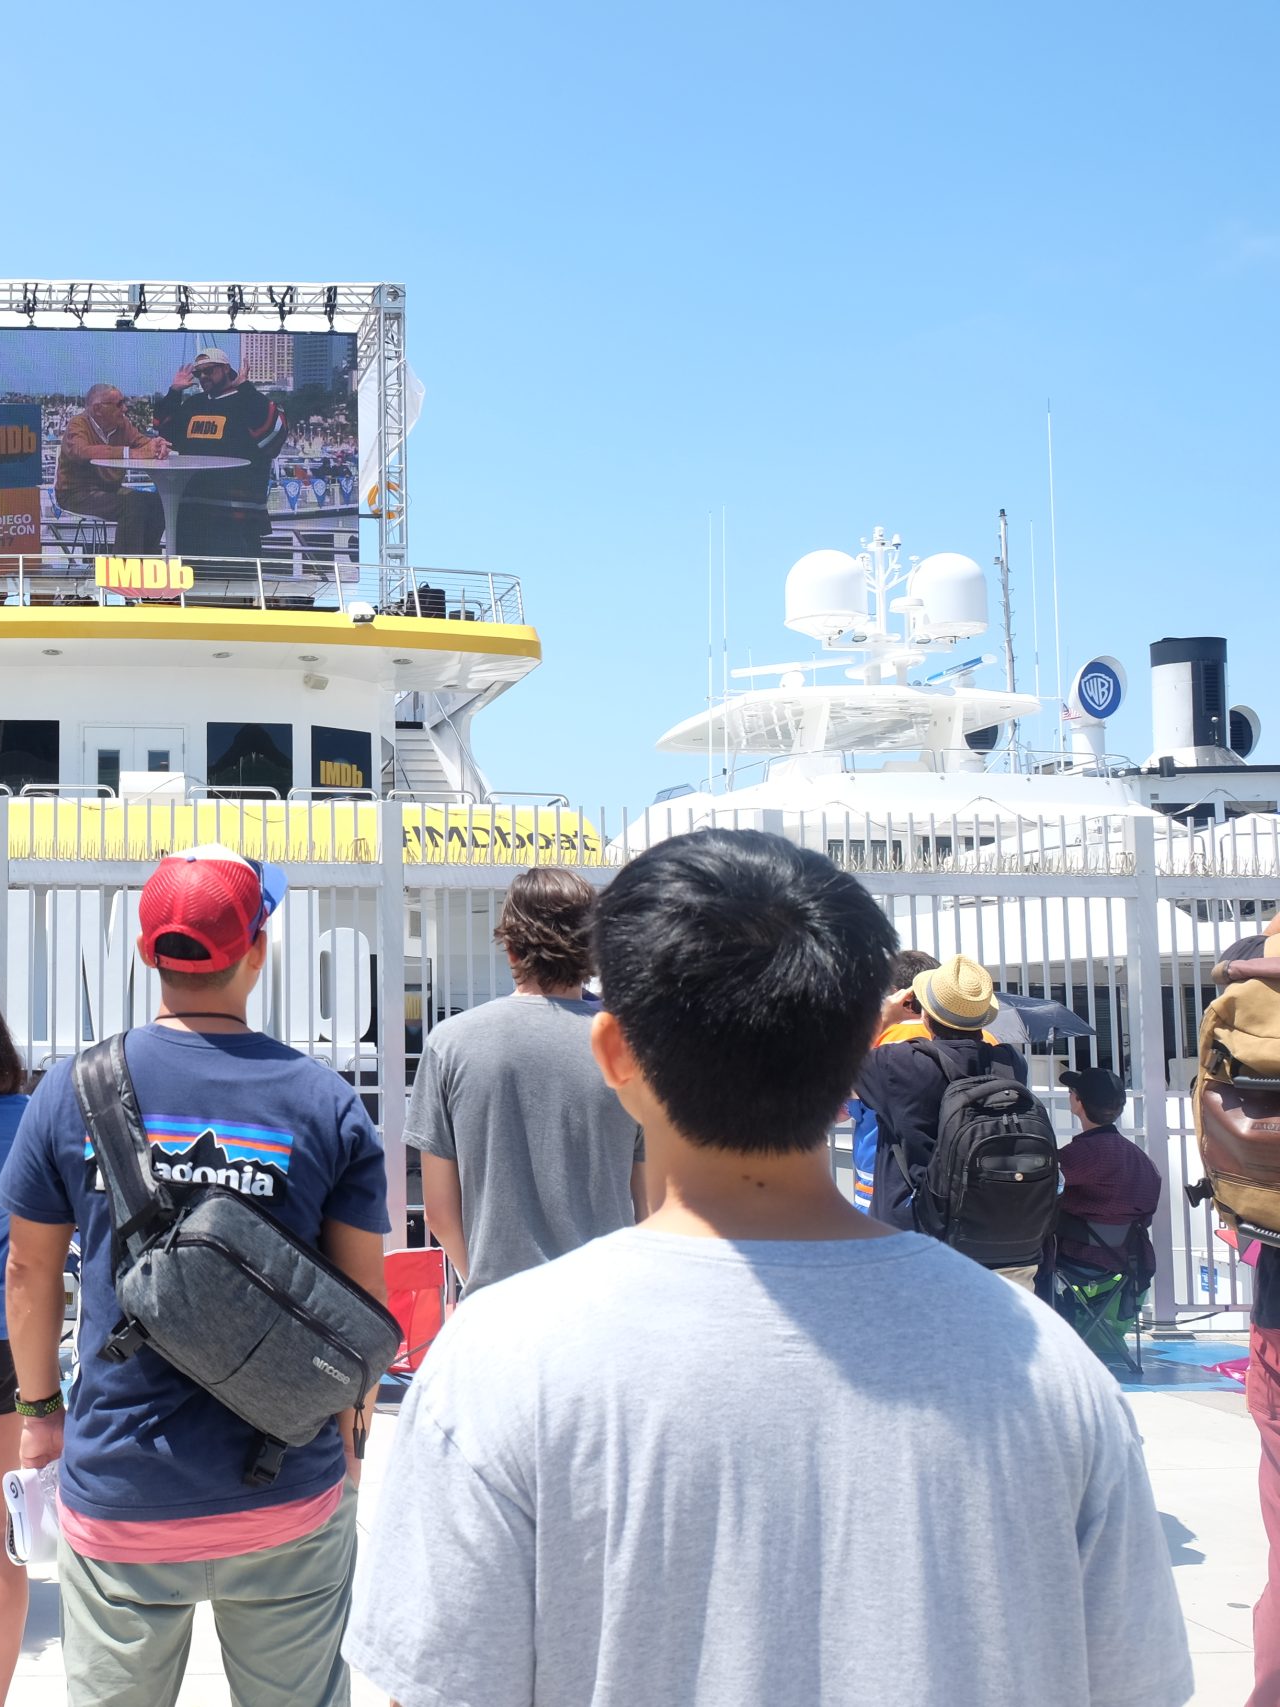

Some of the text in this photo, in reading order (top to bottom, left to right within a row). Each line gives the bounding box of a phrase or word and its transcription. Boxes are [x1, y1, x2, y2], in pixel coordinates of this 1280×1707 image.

[190, 420, 218, 436] IMDb
[95, 556, 195, 590] IMDb
[320, 760, 363, 788] IMDb
